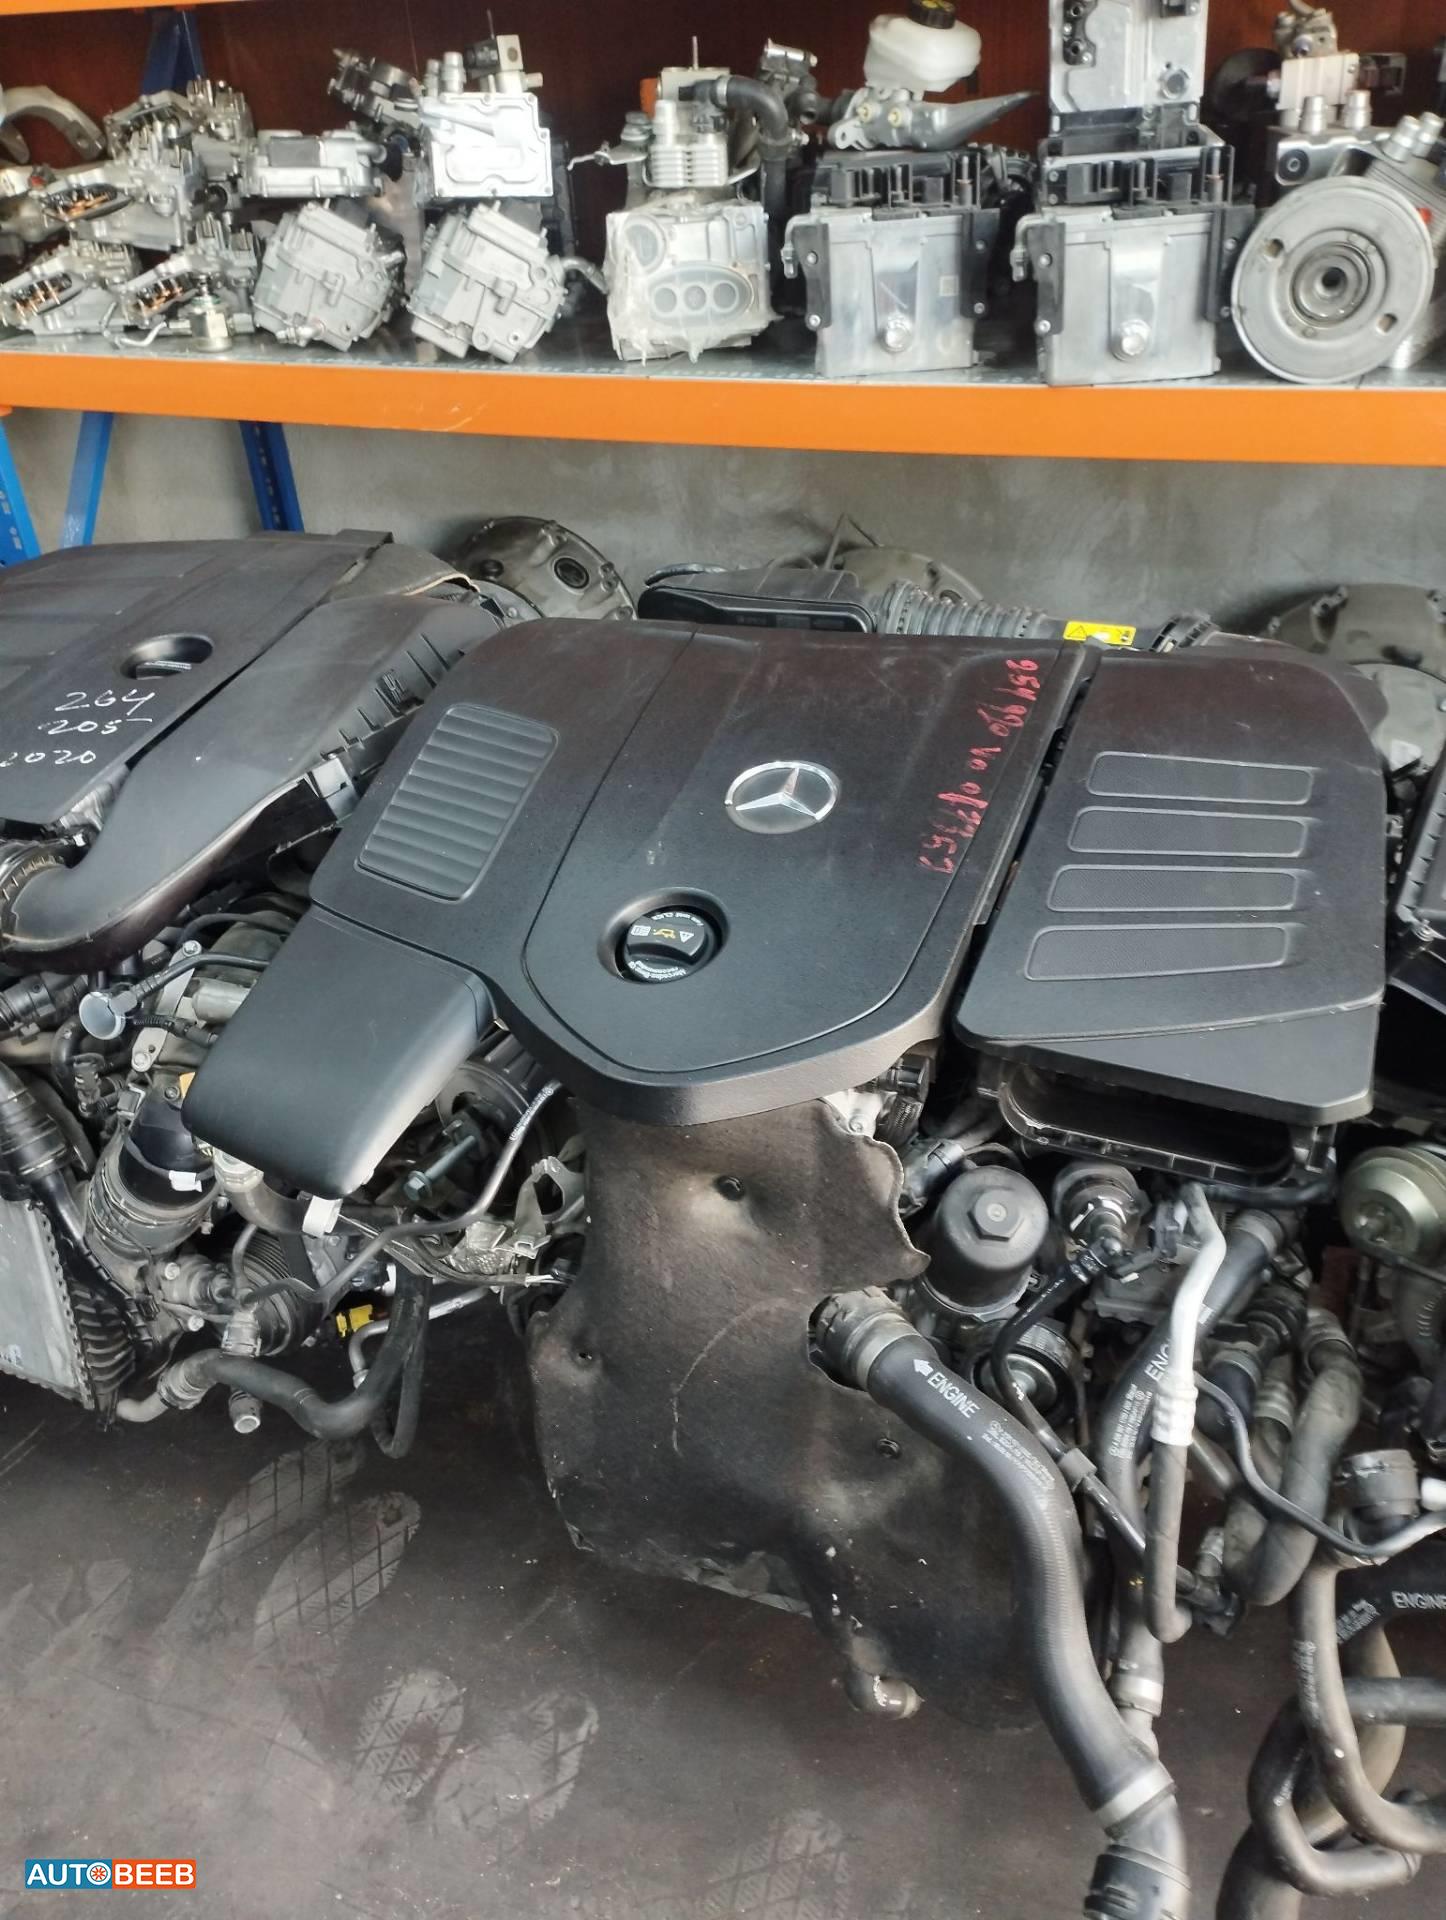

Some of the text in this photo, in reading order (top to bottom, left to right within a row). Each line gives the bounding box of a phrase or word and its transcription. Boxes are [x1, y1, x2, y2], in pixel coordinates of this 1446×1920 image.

[54, 689, 155, 716] 264
[0, 750, 97, 767] 2020
[926, 1371, 981, 1419] ENGINE
